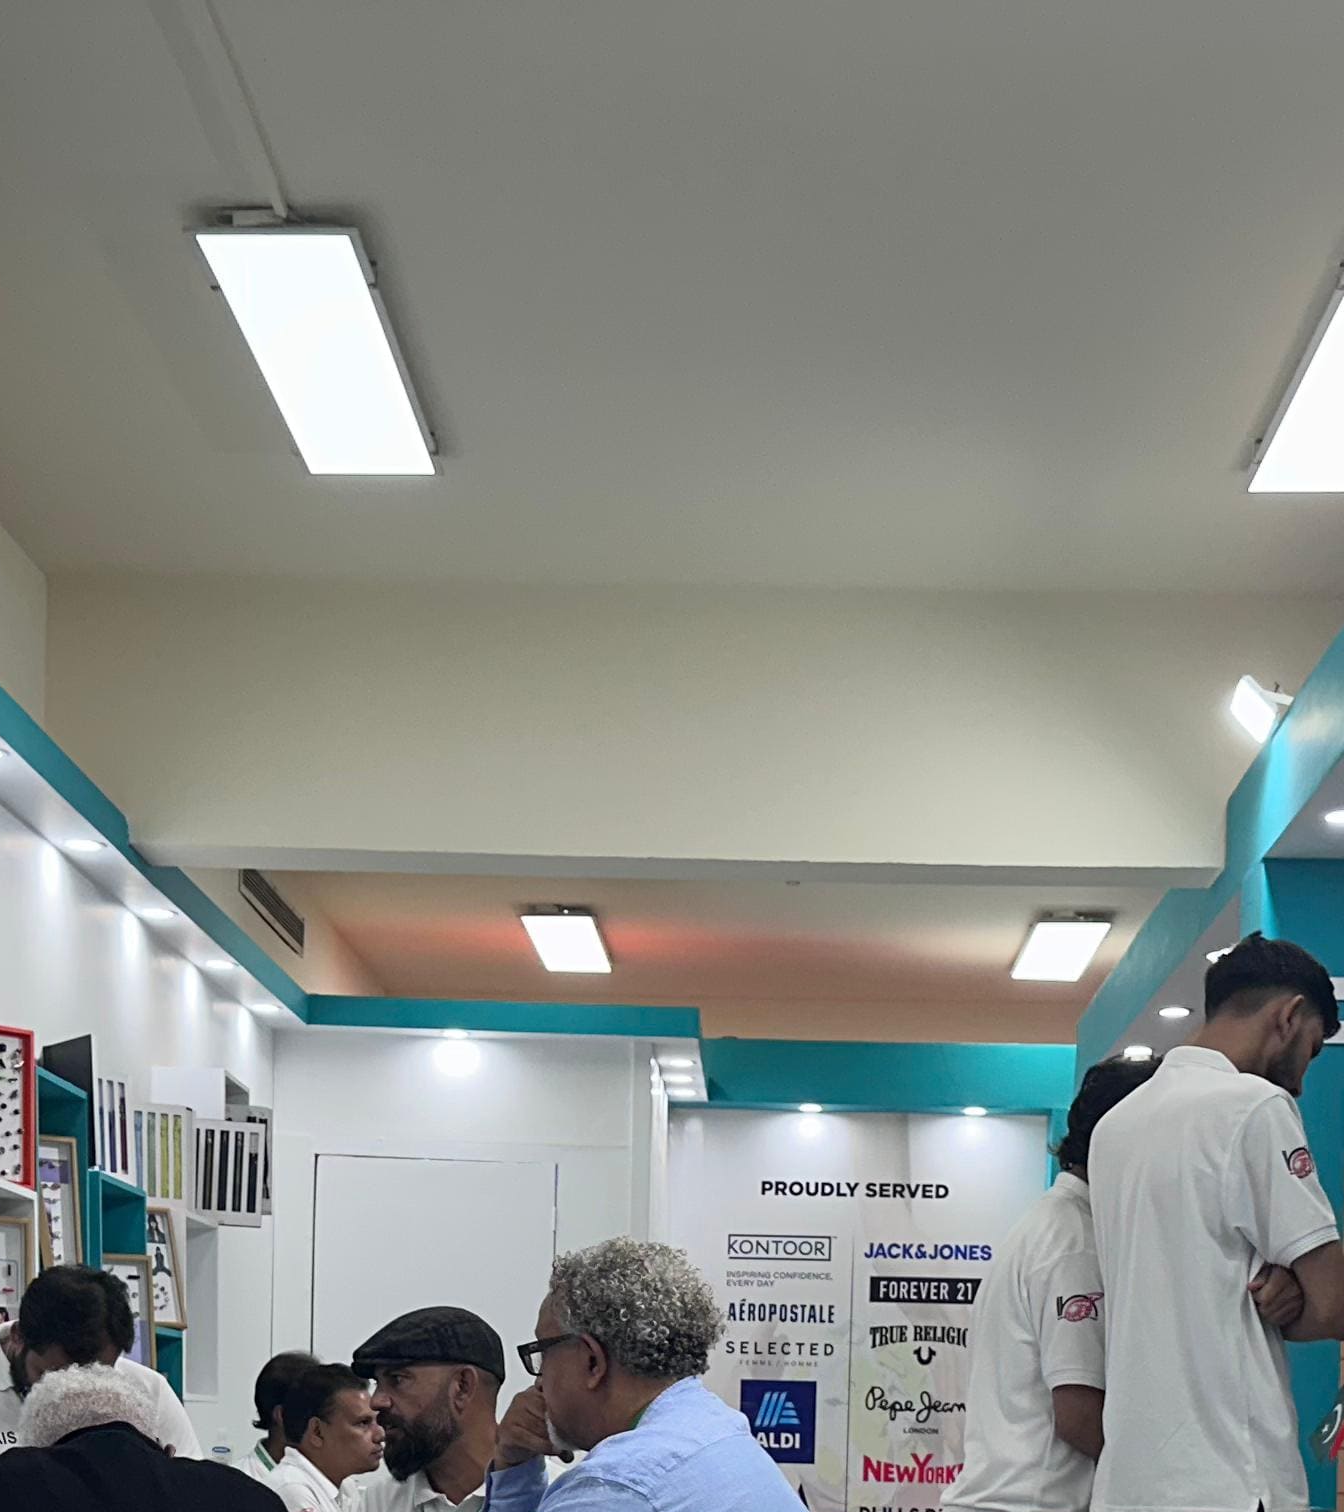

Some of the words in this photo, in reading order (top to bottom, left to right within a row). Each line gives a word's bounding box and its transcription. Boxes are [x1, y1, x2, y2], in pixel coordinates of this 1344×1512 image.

[761, 1180, 859, 1198] PROUDLY
[865, 1183, 949, 1199] SERVED
[729, 1239, 825, 1256] KONTOOR
[864, 1242, 993, 1261] JACK&JONES
[726, 1270, 771, 1280] INSPIRING
[756, 1280, 775, 1288] DAY
[879, 1280, 949, 1300] FOREVER
[956, 1281, 974, 1300] 21
[728, 1298, 835, 1324] AÉROPOSTALE
[869, 1325, 908, 1349] TRUE
[725, 1341, 835, 1356] SELECTED
[865, 1386, 916, 1421] Pepe
[757, 1431, 801, 1449] ALDI
